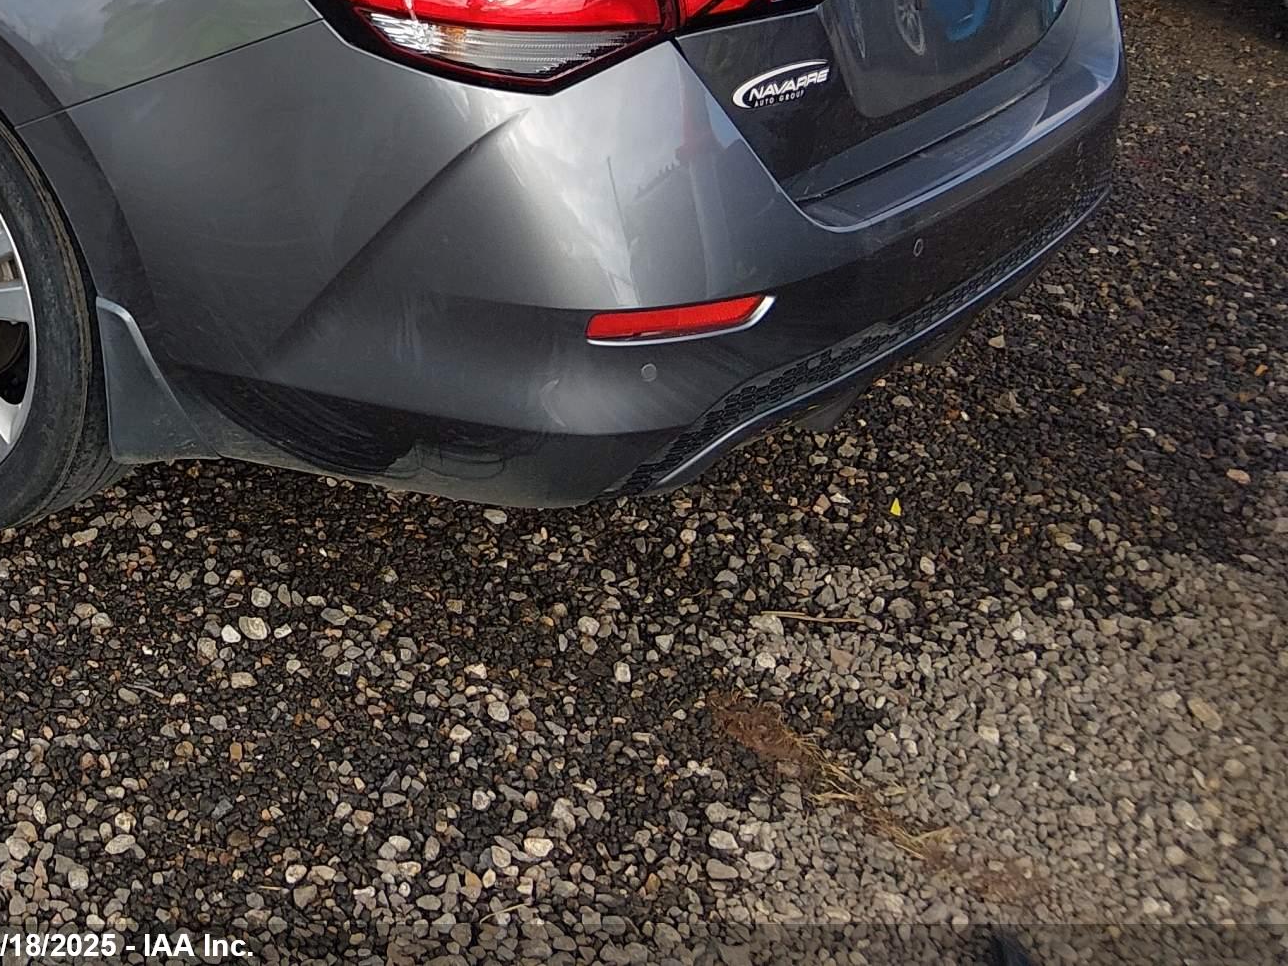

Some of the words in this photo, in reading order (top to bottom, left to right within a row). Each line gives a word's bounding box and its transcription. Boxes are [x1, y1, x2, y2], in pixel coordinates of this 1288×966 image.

[749, 67, 830, 102] NAVARRE
[754, 96, 775, 108] AUTO
[778, 89, 805, 103] GROUP
